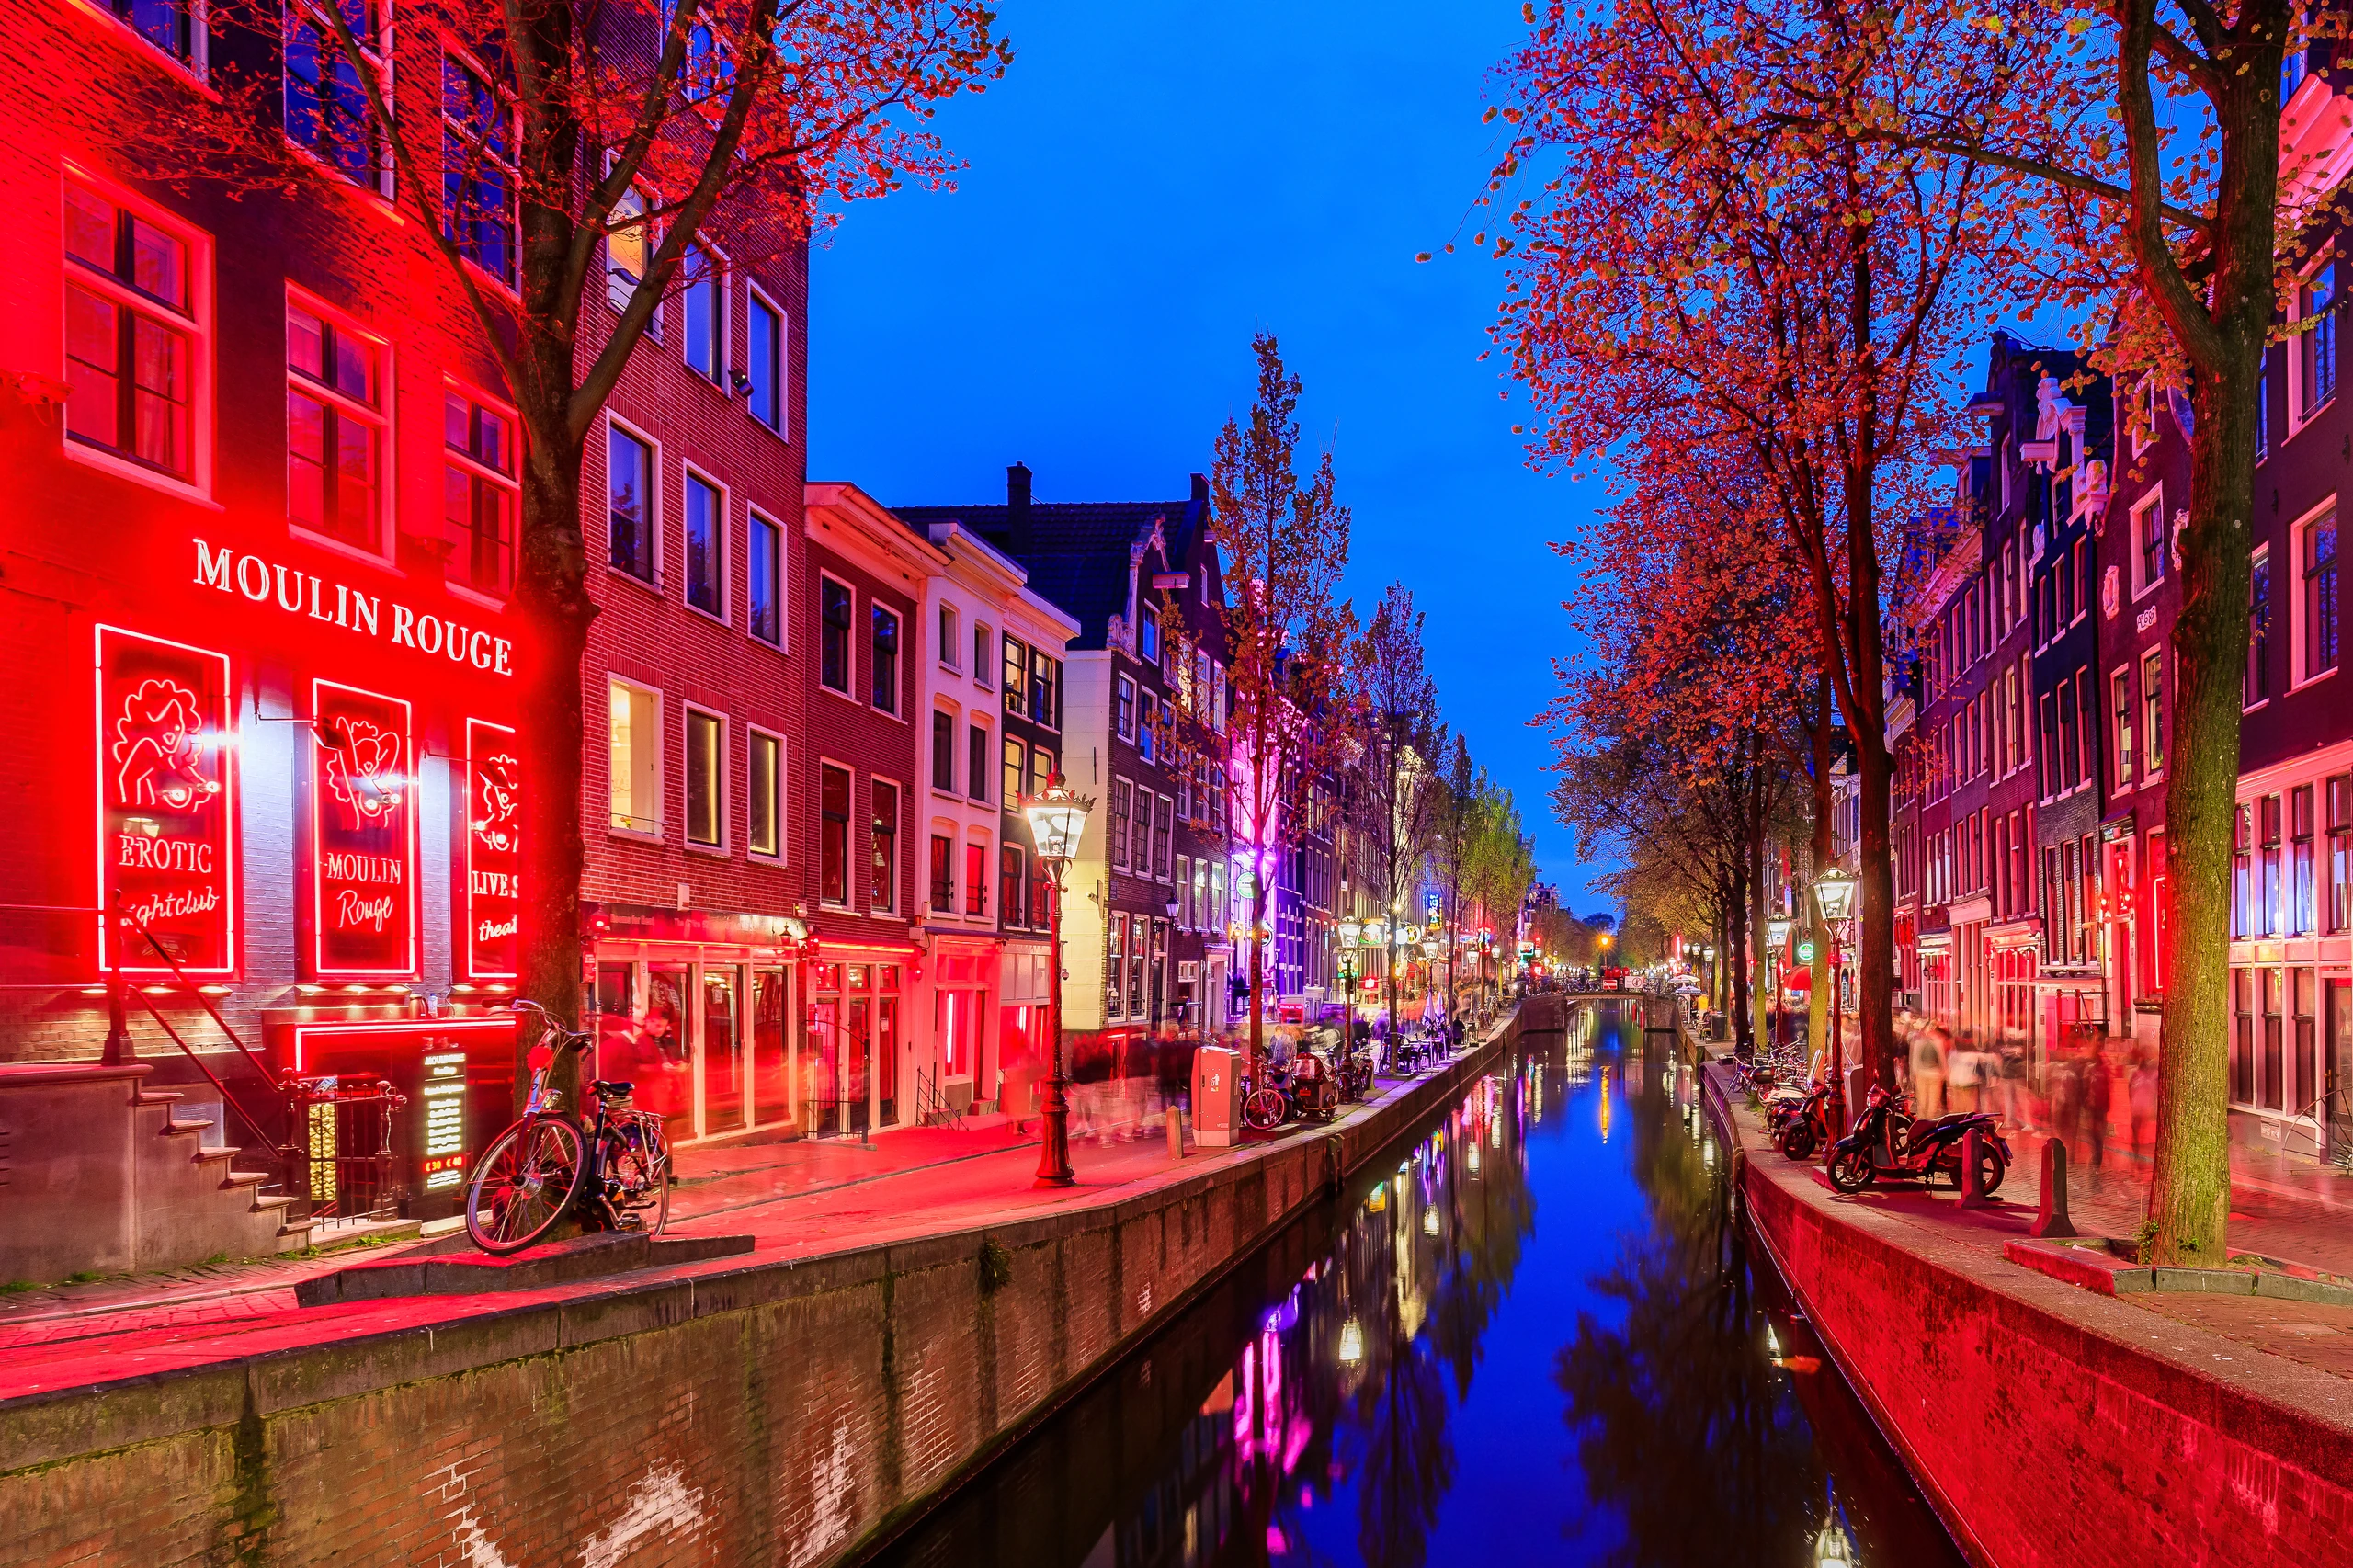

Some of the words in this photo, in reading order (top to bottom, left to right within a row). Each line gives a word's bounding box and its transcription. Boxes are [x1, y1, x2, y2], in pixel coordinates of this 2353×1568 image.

[192, 537, 381, 636] MOULIN
[391, 603, 513, 676] ROUGE
[119, 835, 212, 873] EROTIC
[326, 852, 402, 884] MOULIN
[472, 870, 508, 896] LIVE
[336, 889, 394, 933] Rouge
